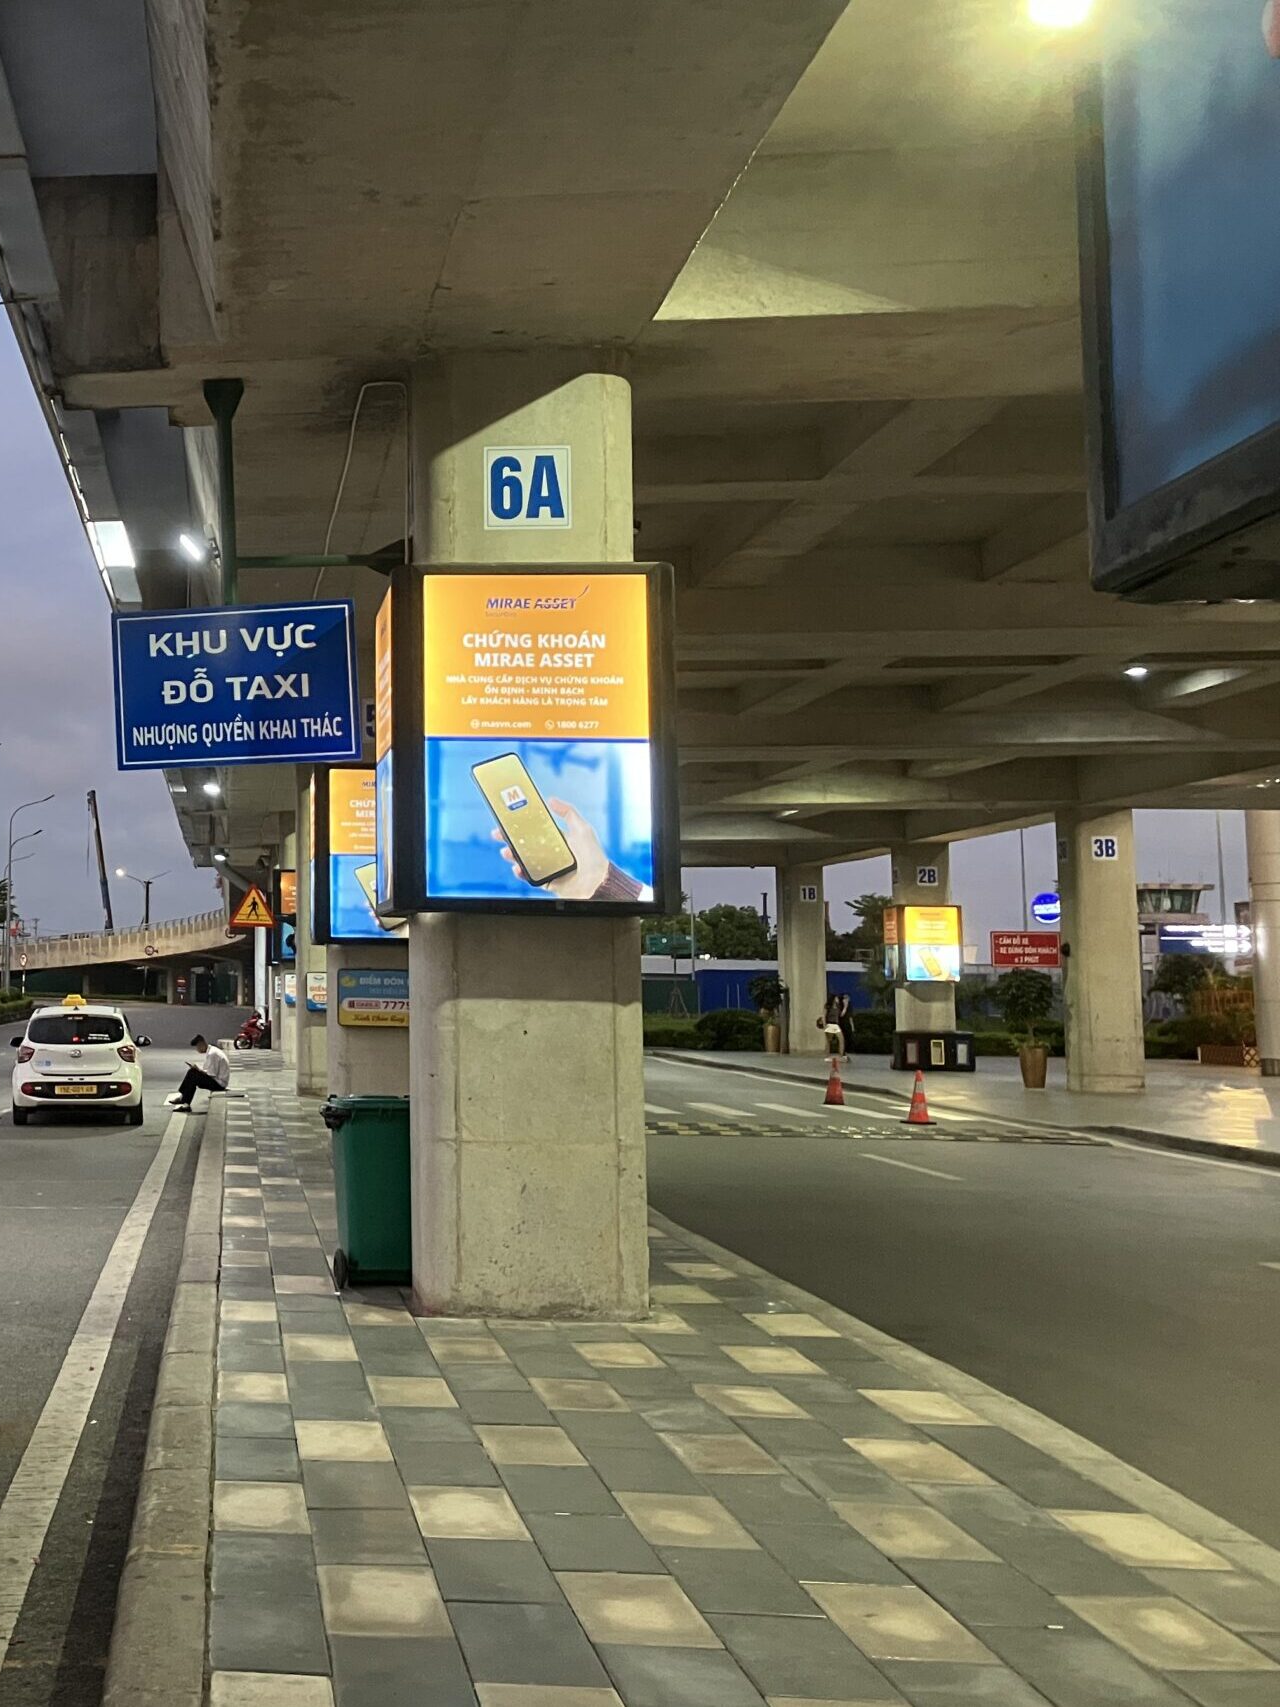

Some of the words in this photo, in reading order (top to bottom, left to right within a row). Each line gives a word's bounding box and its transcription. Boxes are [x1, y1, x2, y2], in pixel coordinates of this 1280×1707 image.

[490, 455, 565, 520] 6A
[486, 597, 531, 609] MIRAE
[534, 597, 577, 609] ASSET
[148, 629, 228, 657] KHU
[239, 622, 317, 657] VỰC
[462, 630, 532, 649] CHỨNG
[537, 630, 606, 648] KHOÁN
[474, 653, 535, 668] MIRAE
[539, 653, 595, 668] ASSET
[162, 667, 214, 705] ĐỖ
[225, 673, 310, 701] TAXI
[468, 675, 494, 684] CUNG
[515, 675, 538, 686] DỊCH
[532, 687, 558, 695] MINH
[132, 724, 198, 750] NHƯỢNG
[202, 714, 255, 748] QUYỀN
[259, 719, 297, 740] KHAI
[300, 712, 343, 738] THÁC
[1093, 839, 1116, 858] 3B
[918, 868, 936, 884] 2B
[802, 887, 816, 900] 1B
